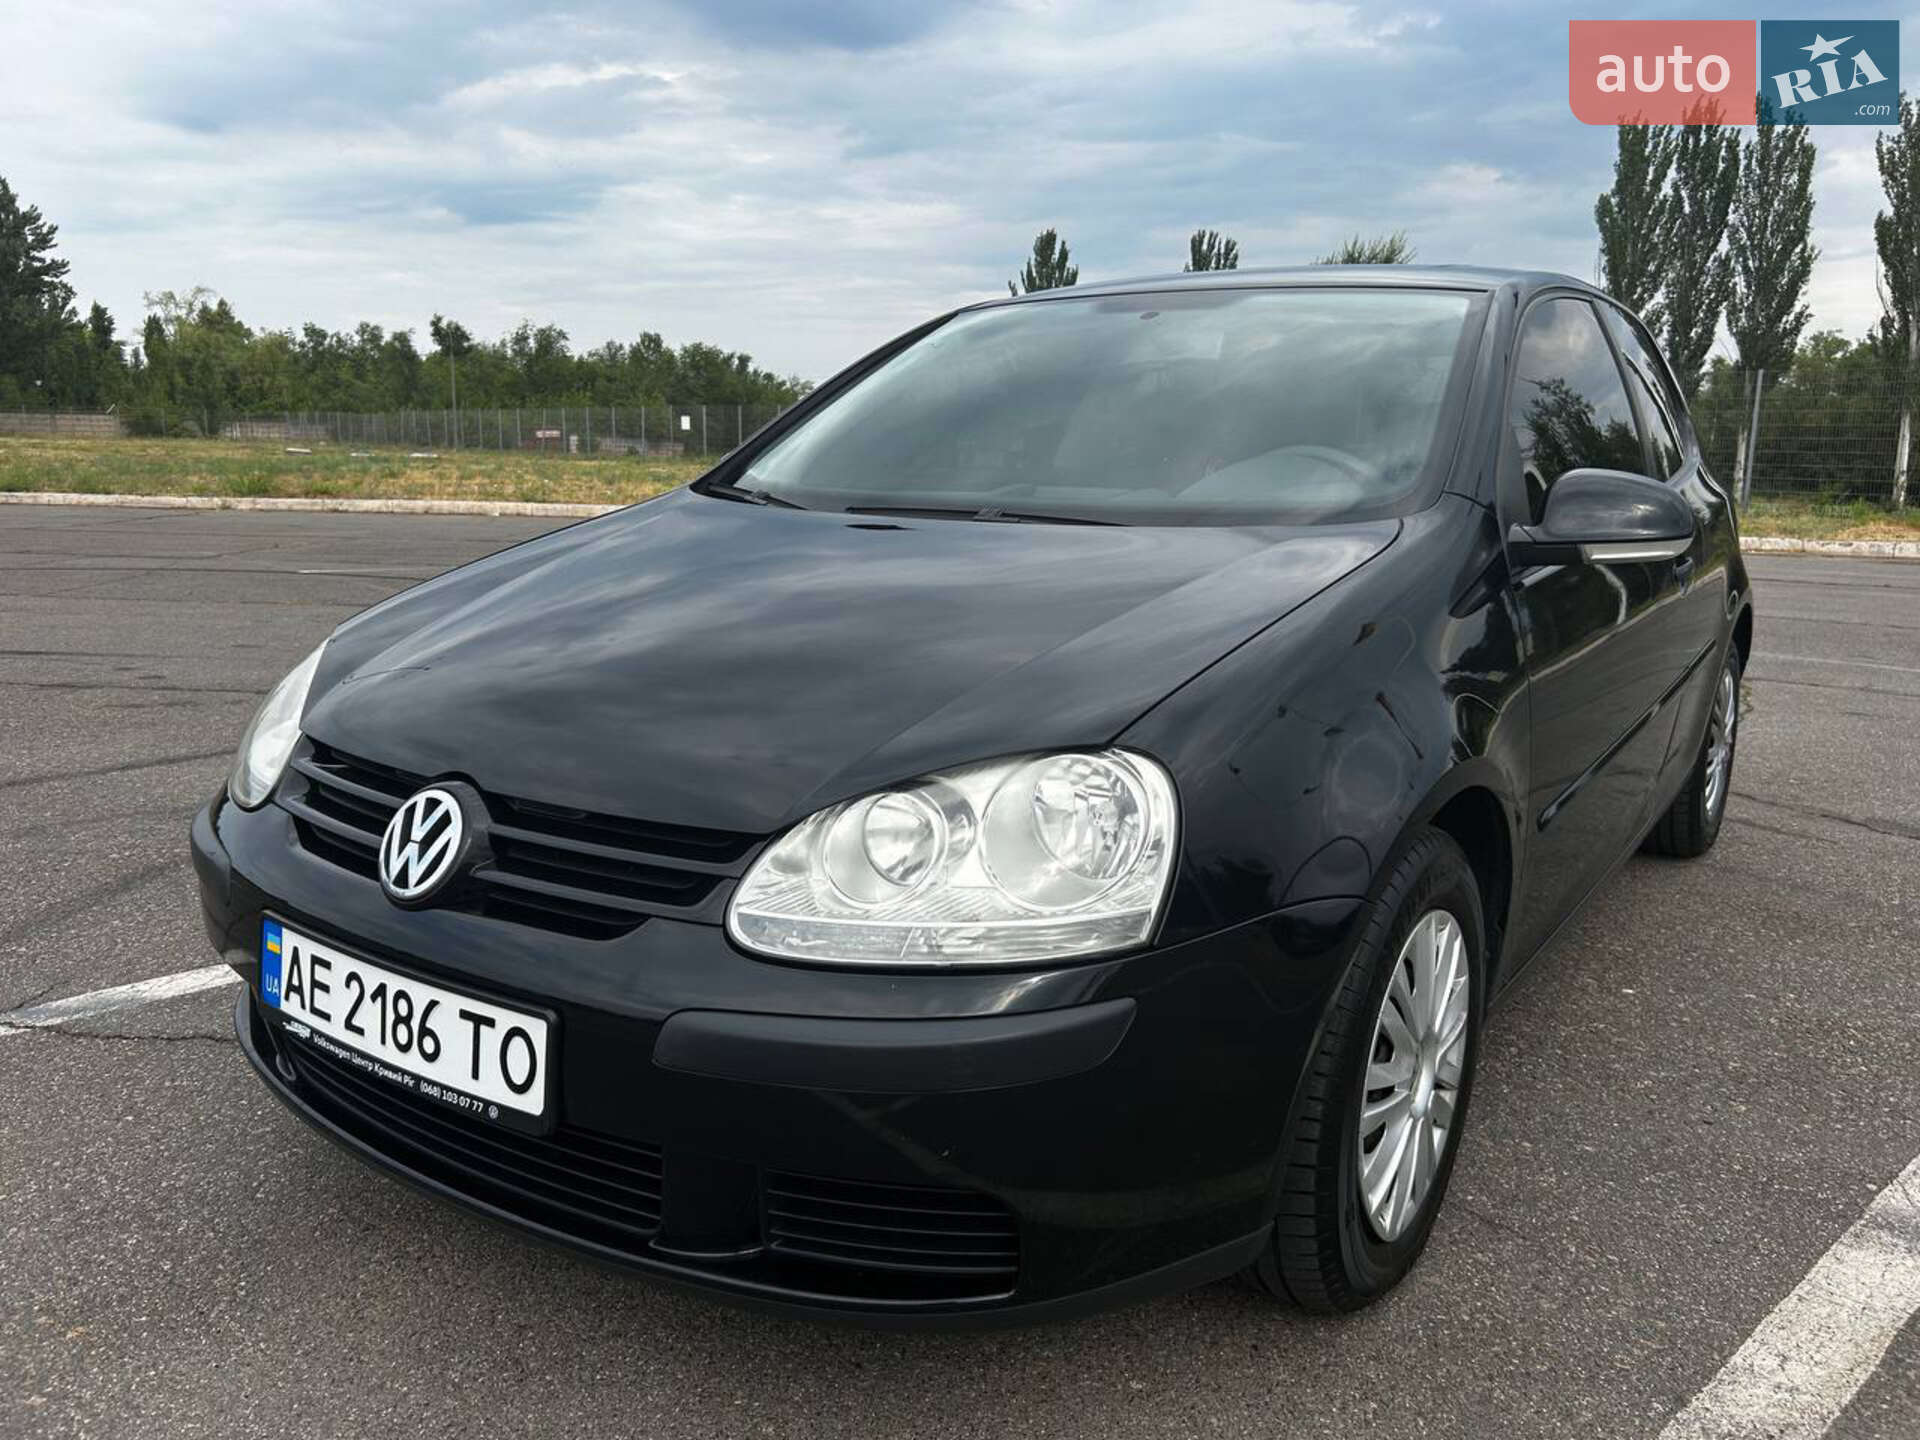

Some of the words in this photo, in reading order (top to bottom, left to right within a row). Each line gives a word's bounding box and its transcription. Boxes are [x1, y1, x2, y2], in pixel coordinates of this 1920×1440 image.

[266, 975, 280, 995] UA
[284, 946, 332, 1023] AE
[344, 971, 441, 1063] 2186
[459, 1008, 537, 1095] TO
[313, 1033, 351, 1059] Volkswagen
[420, 1080, 441, 1099] (068)
[443, 1089, 458, 1104] 103
